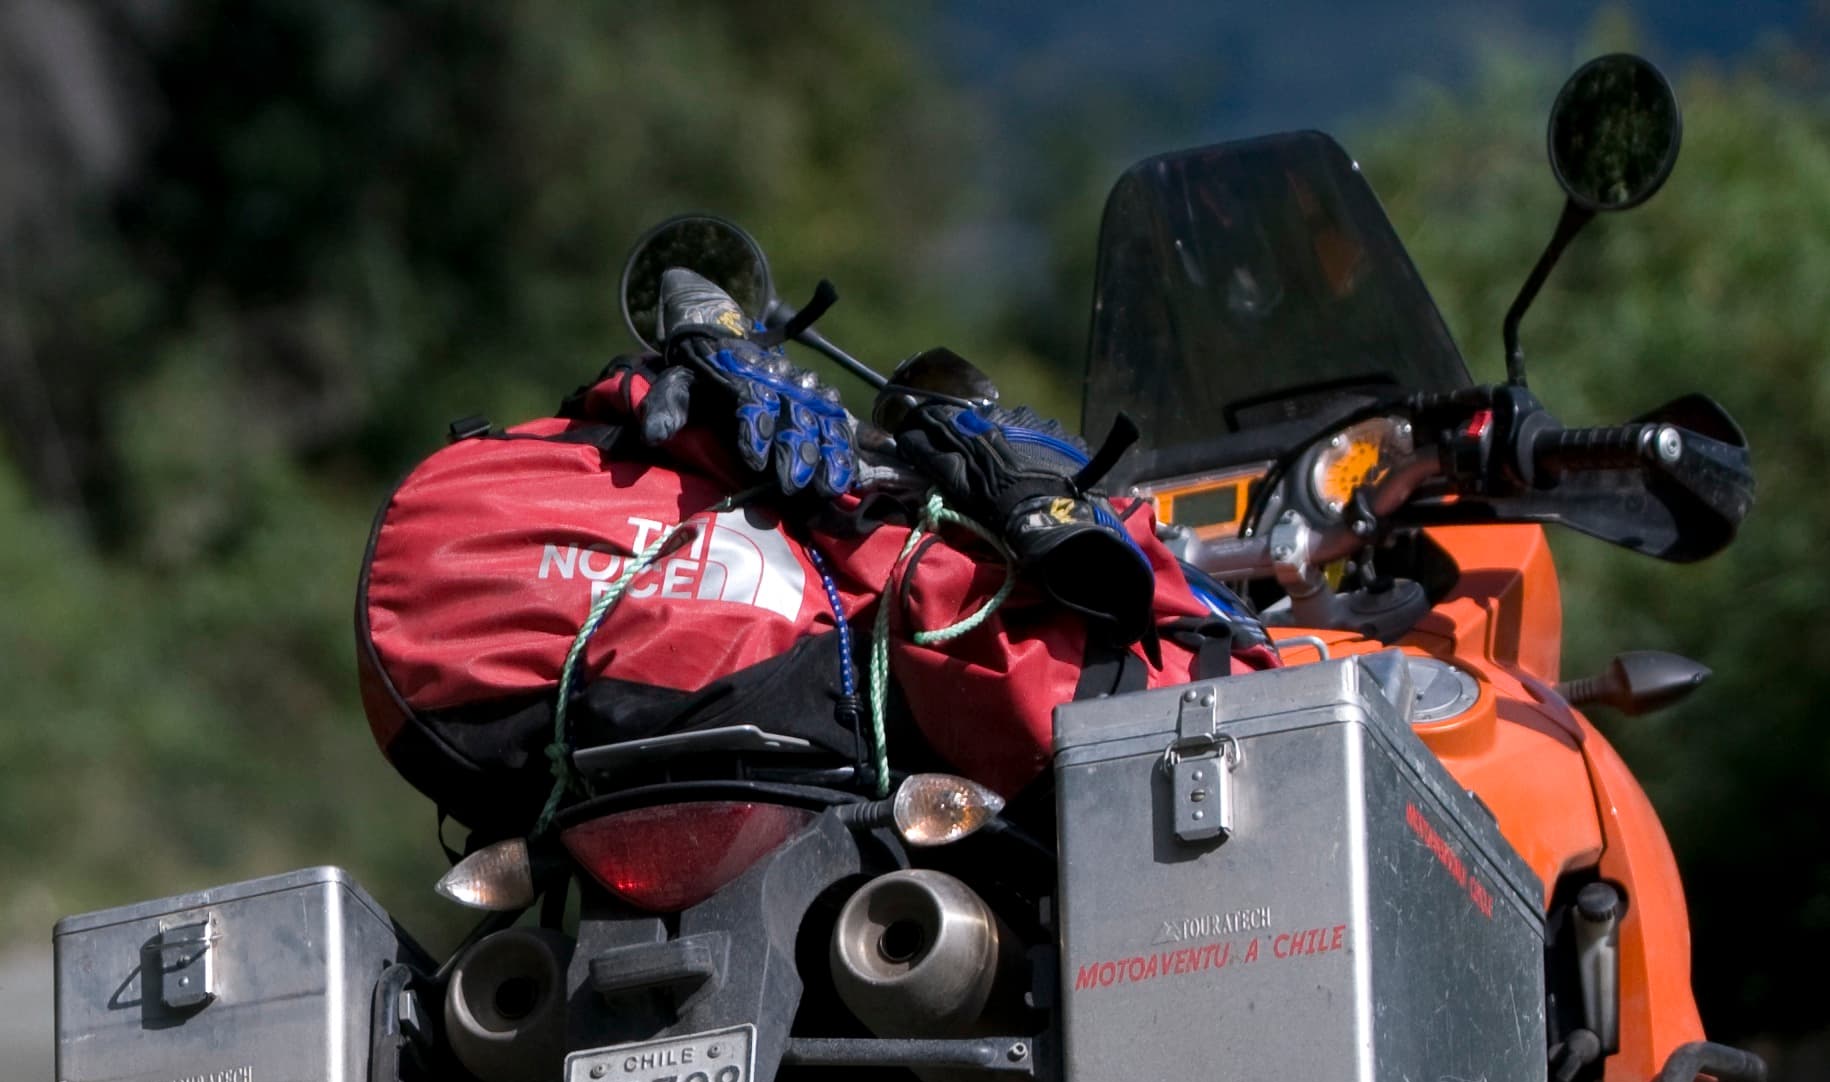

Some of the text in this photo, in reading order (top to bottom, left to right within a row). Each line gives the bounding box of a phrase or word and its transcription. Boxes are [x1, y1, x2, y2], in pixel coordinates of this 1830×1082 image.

[590, 558, 699, 609] FCE
[1182, 906, 1272, 940] TOURATECH
[1273, 924, 1347, 959] CHILE
[623, 1047, 696, 1073] CHILE
